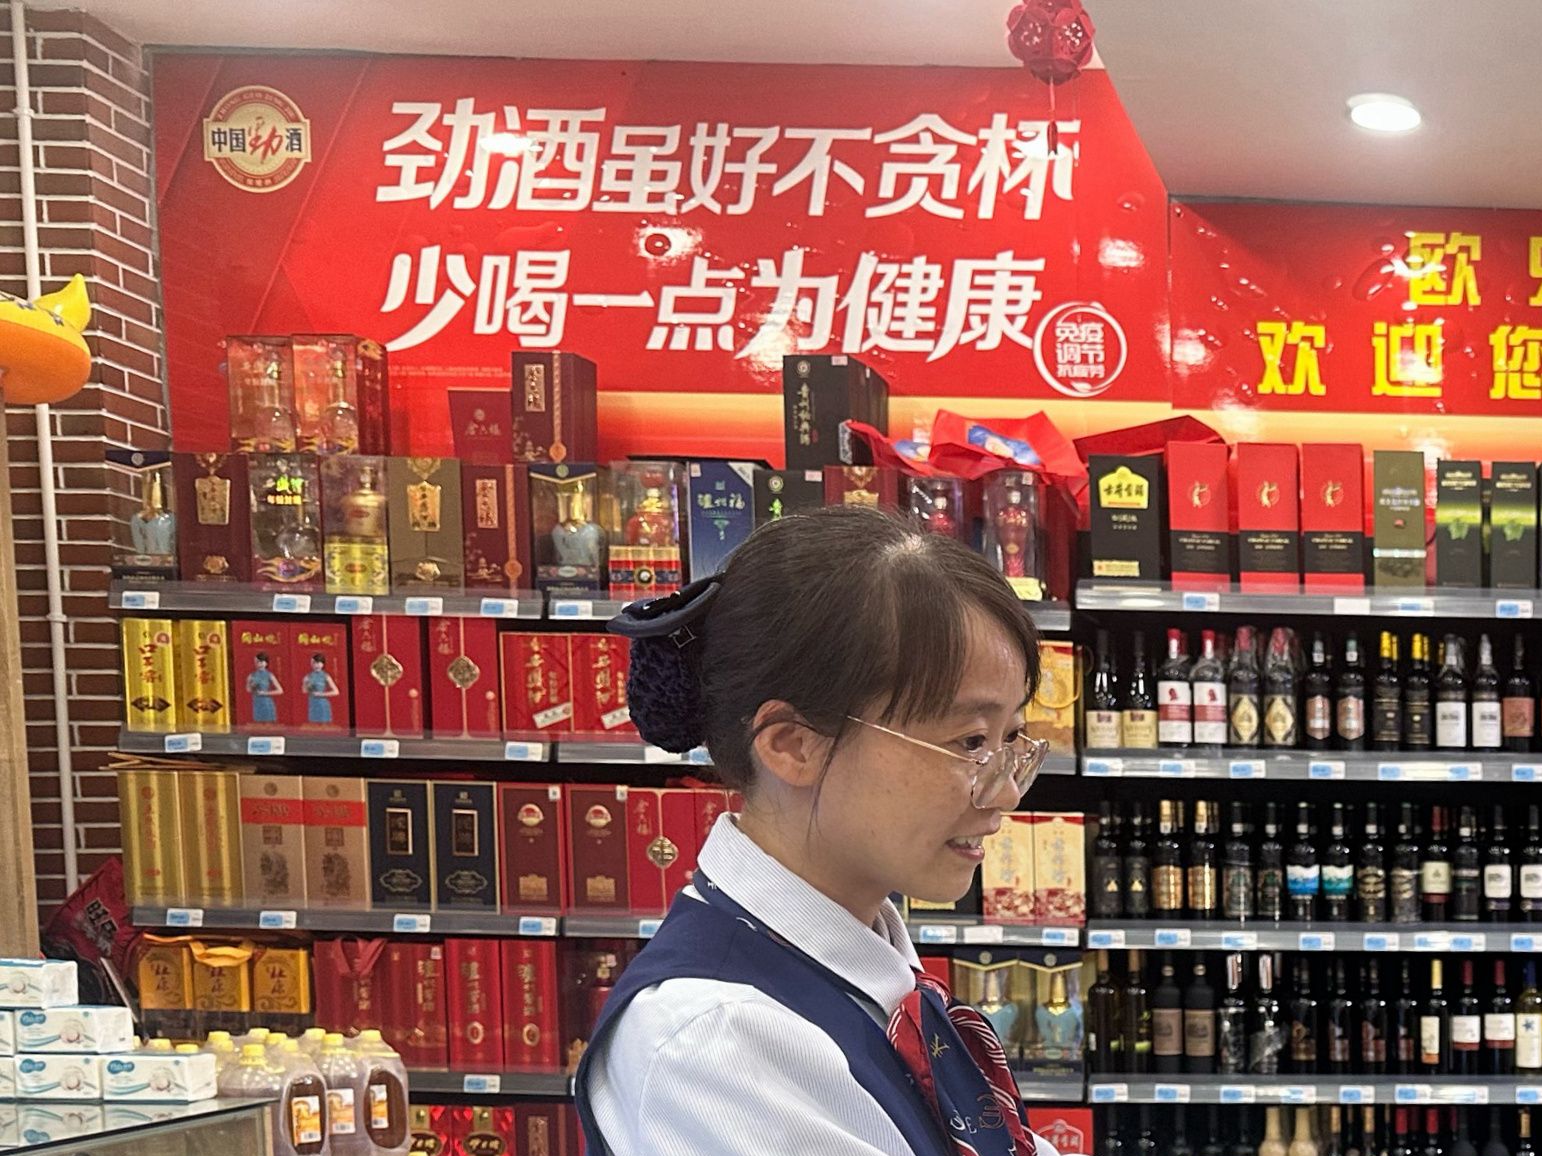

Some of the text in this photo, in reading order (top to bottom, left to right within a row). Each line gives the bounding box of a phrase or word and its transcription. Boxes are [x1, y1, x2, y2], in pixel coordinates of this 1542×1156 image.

[376, 97, 1083, 222] 劲酒虽好不贪杯
[381, 242, 1044, 358] 少喝一点为健康
[1055, 322, 1104, 343] 免疫
[1055, 343, 1105, 364] 调节
